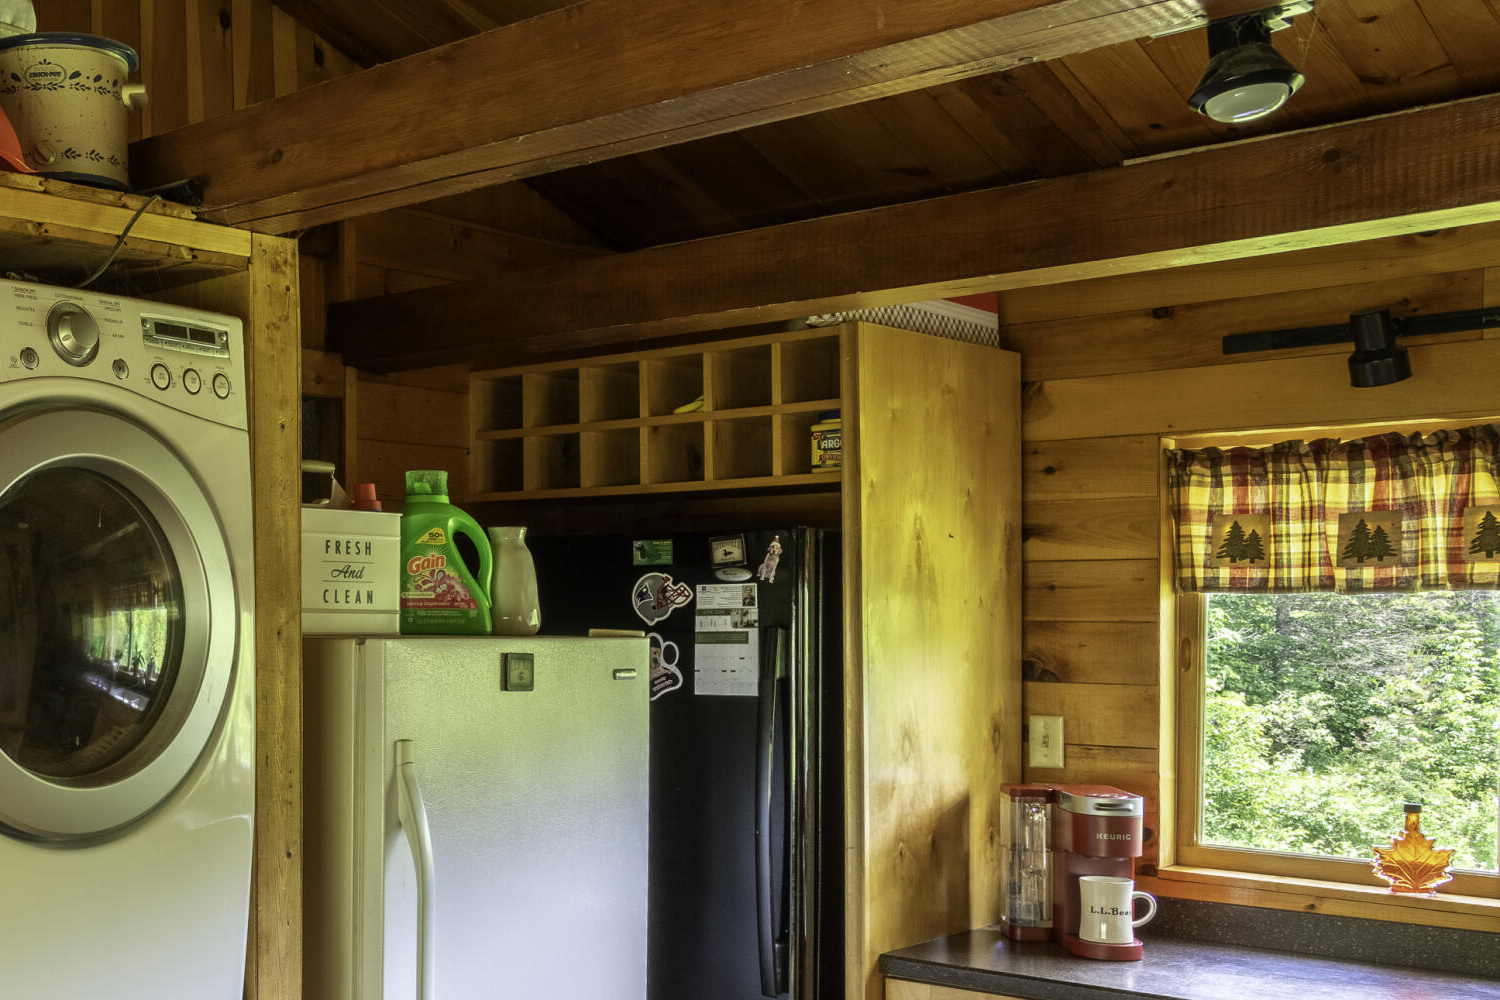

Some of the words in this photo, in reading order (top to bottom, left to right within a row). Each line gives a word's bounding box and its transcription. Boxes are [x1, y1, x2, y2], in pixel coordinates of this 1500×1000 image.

[324, 539, 372, 556] FRESH
[330, 564, 365, 580] And
[407, 553, 447, 576] Gain
[322, 588, 374, 605] CLEAN
[1096, 832, 1132, 841] KEURIG
[1090, 905, 1132, 916] L.L.Bea
